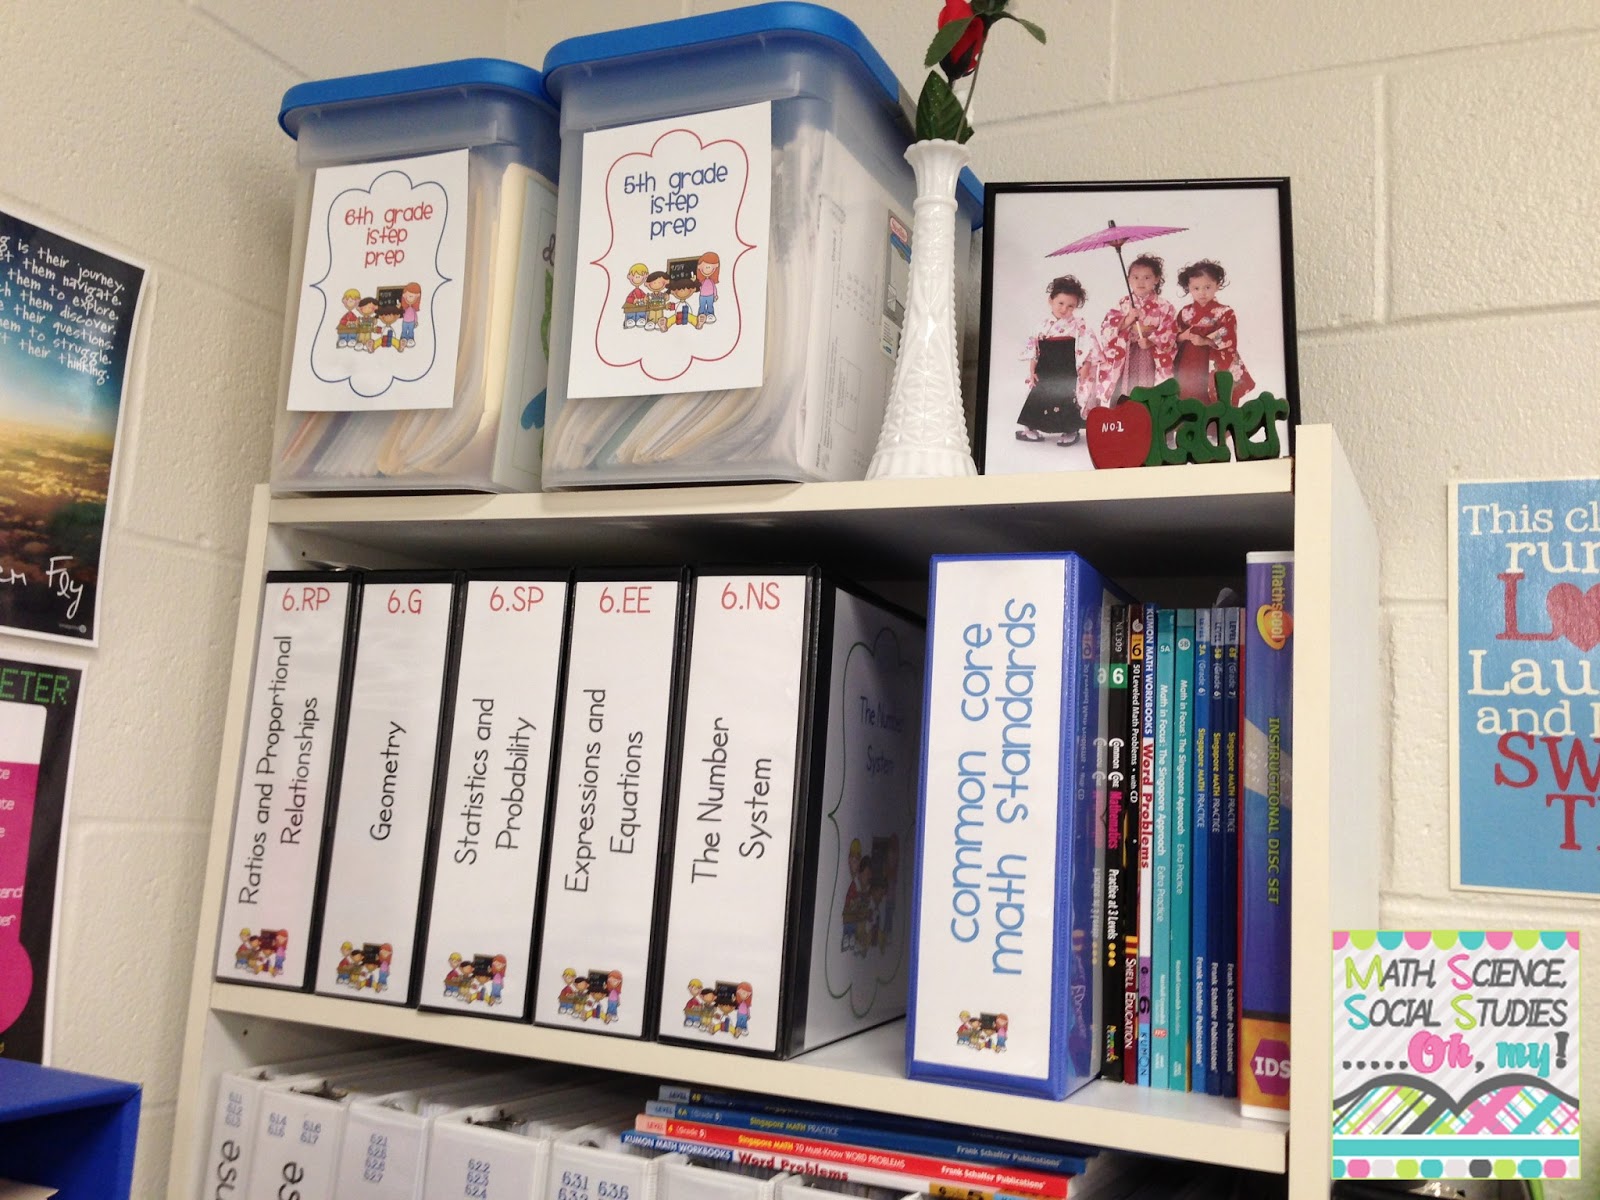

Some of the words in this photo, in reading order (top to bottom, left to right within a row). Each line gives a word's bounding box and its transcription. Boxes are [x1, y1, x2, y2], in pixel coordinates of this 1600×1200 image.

[623, 173, 656, 195] 5th
[668, 162, 729, 197] grade
[344, 206, 374, 227] 6th
[383, 201, 434, 231] grade
[649, 192, 699, 216] istep
[365, 226, 409, 248] istep
[649, 216, 697, 241] prep
[18, 238, 29, 254] is
[37, 247, 70, 269] their
[77, 262, 126, 295] journey.
[364, 247, 405, 269] prep
[7, 268, 41, 290] them
[49, 285, 65, 300] to
[72, 296, 119, 321] explore.
[22, 257, 56, 280] them
[62, 276, 122, 306] navigate.
[13, 303, 46, 323] their
[53, 321, 114, 350] questions.
[20, 289, 53, 311] them
[59, 305, 117, 335] discover.
[19, 339, 50, 358] their
[29, 326, 45, 341] to
[53, 337, 112, 366] struggle.
[1131, 371, 1290, 466] Teacher
[1463, 501, 1554, 534] This
[46, 555, 84, 620] Fly
[281, 586, 331, 612] 6.RP
[387, 588, 423, 615] 6.G
[489, 586, 545, 613] 6.SP
[599, 586, 652, 614] 6.EE
[721, 581, 780, 610] 6.NS
[1146, 608, 1155, 643] KUMON
[1132, 642, 1143, 657] 6
[1132, 663, 1141, 674] 50
[1145, 645, 1155, 671] MATH
[960, 622, 994, 723] core
[1112, 667, 1125, 685] 6
[1132, 675, 1141, 705] Leveled
[256, 635, 293, 775] Proportional
[992, 596, 1037, 824] standards
[1132, 706, 1140, 727] Math
[1144, 672, 1154, 735] WORKBOOKS
[1160, 684, 1168, 710] Math
[1476, 699, 1576, 737] and
[1131, 728, 1139, 766] Problems
[1142, 743, 1153, 786] Word
[1159, 749, 1167, 766] The
[1178, 738, 1186, 754] The
[1197, 728, 1206, 766] Singapore
[1212, 732, 1221, 771] Singapore
[1227, 732, 1236, 771] Singapore
[280, 696, 320, 845] Relationships
[369, 720, 407, 841] Geometry
[454, 749, 489, 865] Statistics
[472, 697, 495, 740] and
[495, 716, 537, 850] Probability
[697, 716, 730, 822] Number
[1177, 754, 1186, 795] Singapore
[1213, 773, 1221, 797] MATH
[1227, 774, 1235, 796] MATH
[1268, 717, 1280, 834] INSTRUCTIONAL
[254, 783, 274, 823] and
[564, 741, 602, 893] Expressions
[583, 688, 606, 733] and
[609, 729, 644, 854] Equations
[739, 757, 773, 859] System
[1130, 791, 1138, 804] CD
[1156, 766, 1167, 814] Singapore
[1176, 796, 1185, 835] Approach
[1197, 793, 1205, 828] PRACTICE
[1212, 798, 1220, 833] PRACTICE
[1227, 798, 1235, 833] PRACTICE
[950, 749, 987, 944] common
[1141, 792, 1153, 869] Problems
[1156, 814, 1166, 857] Approach
[238, 832, 267, 905] Ratios
[691, 831, 722, 884] The
[1268, 838, 1280, 874] DISC
[1108, 869, 1120, 899] Practice
[1268, 877, 1280, 904] SET
[986, 853, 1028, 977] math
[1107, 916, 1118, 940] Levels
[1124, 958, 1136, 988] SHELL
[1124, 992, 1136, 1049] EDUCATION
[750, 1117, 785, 1130] Singapore
[786, 1122, 806, 1132] MATH
[807, 1125, 840, 1137] PRACTICE
[957, 1145, 979, 1156] Frank
[624, 1134, 655, 1148] KUMON
[655, 1138, 677, 1151] MATH
[679, 1142, 731, 1160] WORKBOOKS
[739, 1152, 775, 1169] Word
[780, 1159, 849, 1181] Problems
[738, 1134, 773, 1149] Singapore
[773, 1139, 794, 1150] MATH
[844, 1150, 867, 1163] WORD
[868, 1154, 906, 1169] PROBLEMS
[941, 1165, 964, 1177] Frank
[996, 1174, 1047, 1190] Publications
